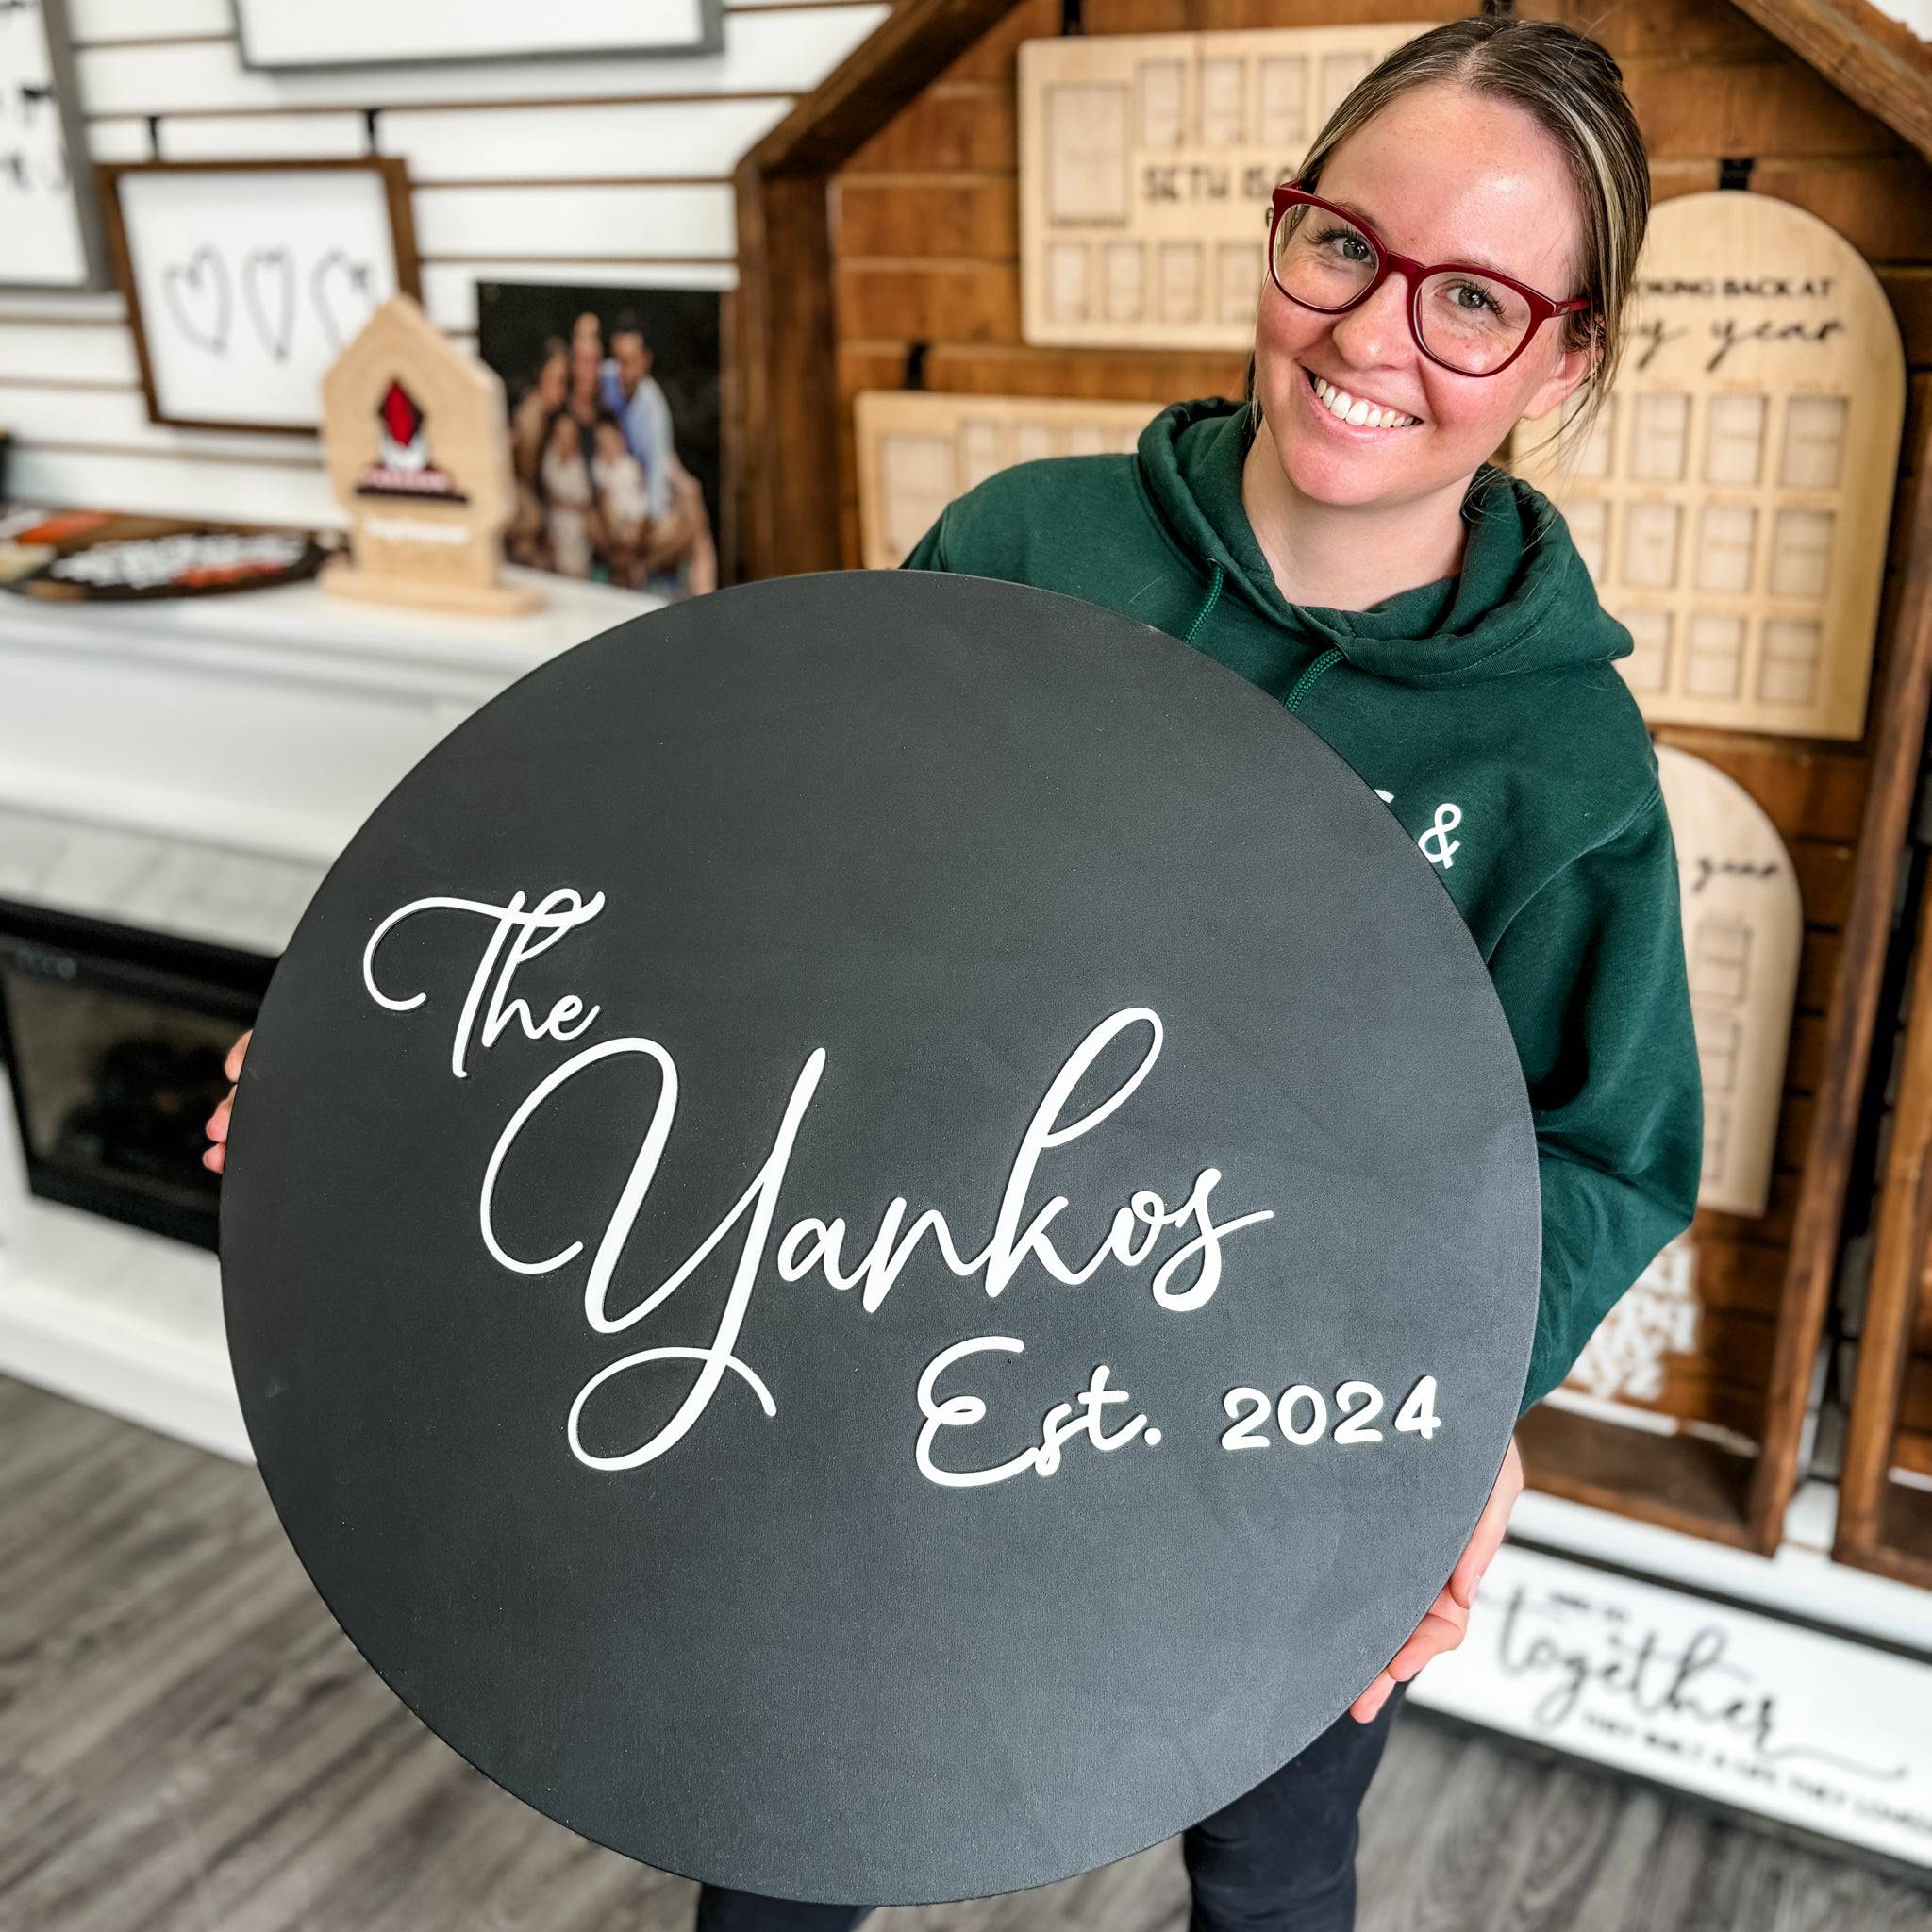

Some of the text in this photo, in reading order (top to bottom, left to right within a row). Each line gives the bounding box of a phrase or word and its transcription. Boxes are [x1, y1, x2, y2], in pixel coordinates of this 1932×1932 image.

[1704, 316, 1846, 374] year
[1723, 279, 1790, 297] BACK
[1801, 279, 1834, 297] AT
[1418, 803, 1462, 869] &
[363, 889, 605, 1077] The
[480, 1008, 1275, 1471] Yankos
[916, 1336, 1444, 1489] Est. 2024
[1495, 1583, 1909, 1783] together
